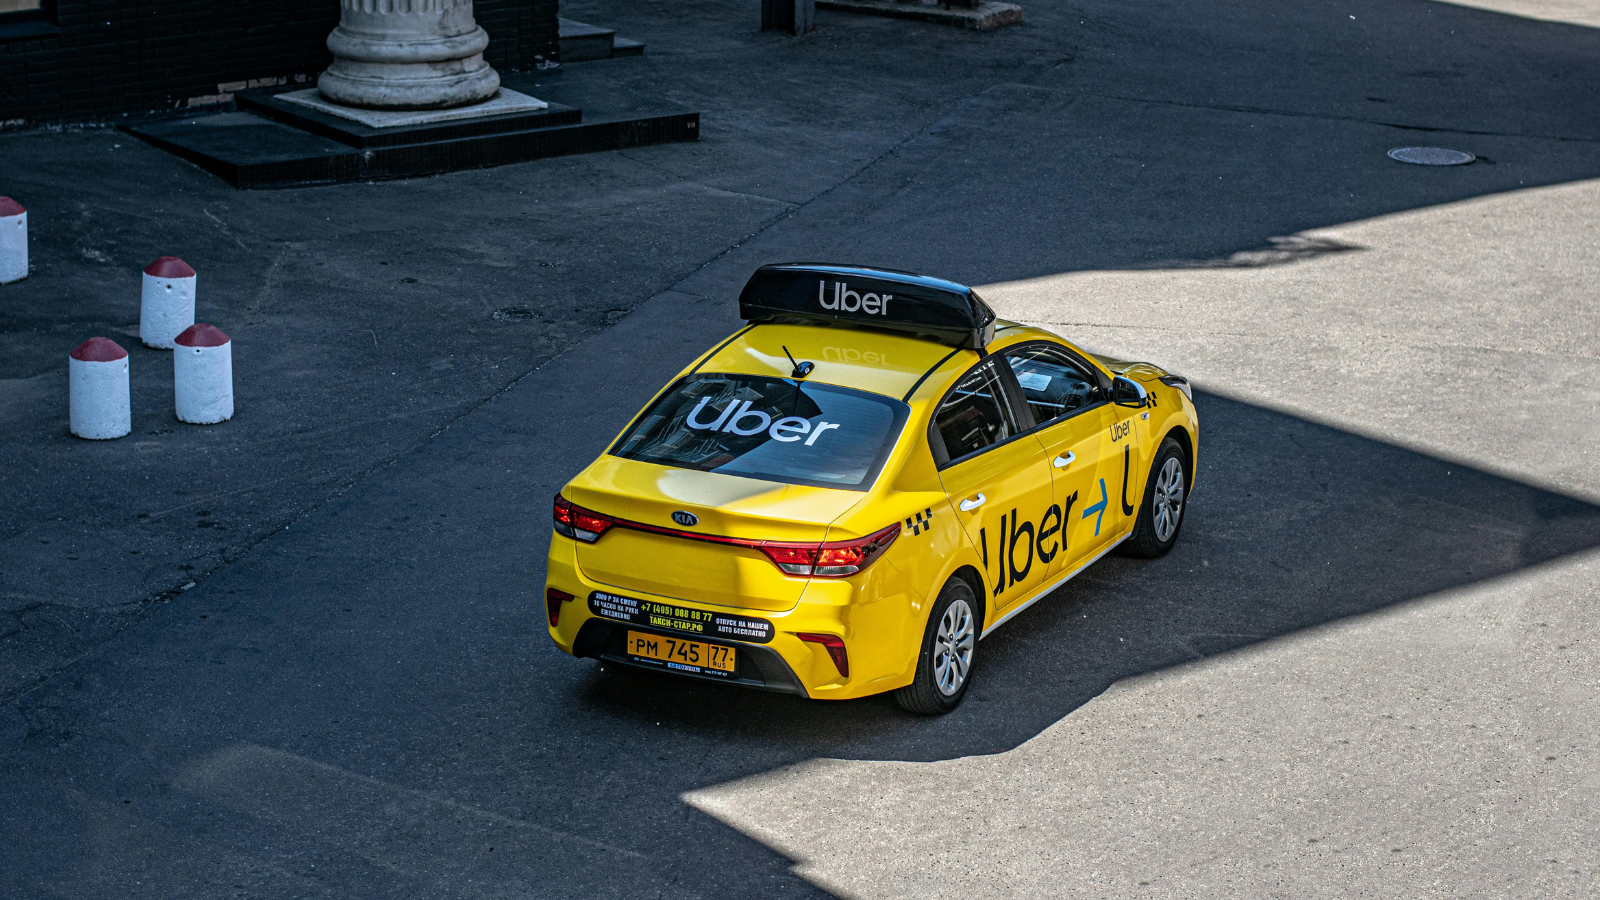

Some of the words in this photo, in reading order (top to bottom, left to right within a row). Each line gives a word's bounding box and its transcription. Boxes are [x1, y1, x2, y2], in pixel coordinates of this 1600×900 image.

[818, 279, 893, 315] Uber
[686, 396, 840, 446] Uber
[1110, 419, 1130, 443] Uber
[674, 512, 694, 525] KIA
[980, 489, 1079, 597] Uber
[600, 601, 617, 610] ЧАСОВ
[625, 606, 639, 615] РУКИ
[600, 608, 631, 620] ЕЖЕДНЕВНО
[641, 603, 652, 612] +7
[652, 604, 673, 617] (495)
[691, 610, 701, 620] 88
[702, 612, 713, 622] 77
[649, 615, 703, 632] ТАКСИ-СТАР.РФ
[715, 617, 737, 627] ОТПУСК
[738, 620, 746, 628] НА
[747, 621, 769, 631] НАШЕМ
[718, 625, 733, 634] АВТО
[733, 627, 766, 638] БЕСПЛАТНО
[666, 639, 700, 662] 745
[711, 645, 729, 662] 77
[712, 661, 727, 669] RUS
